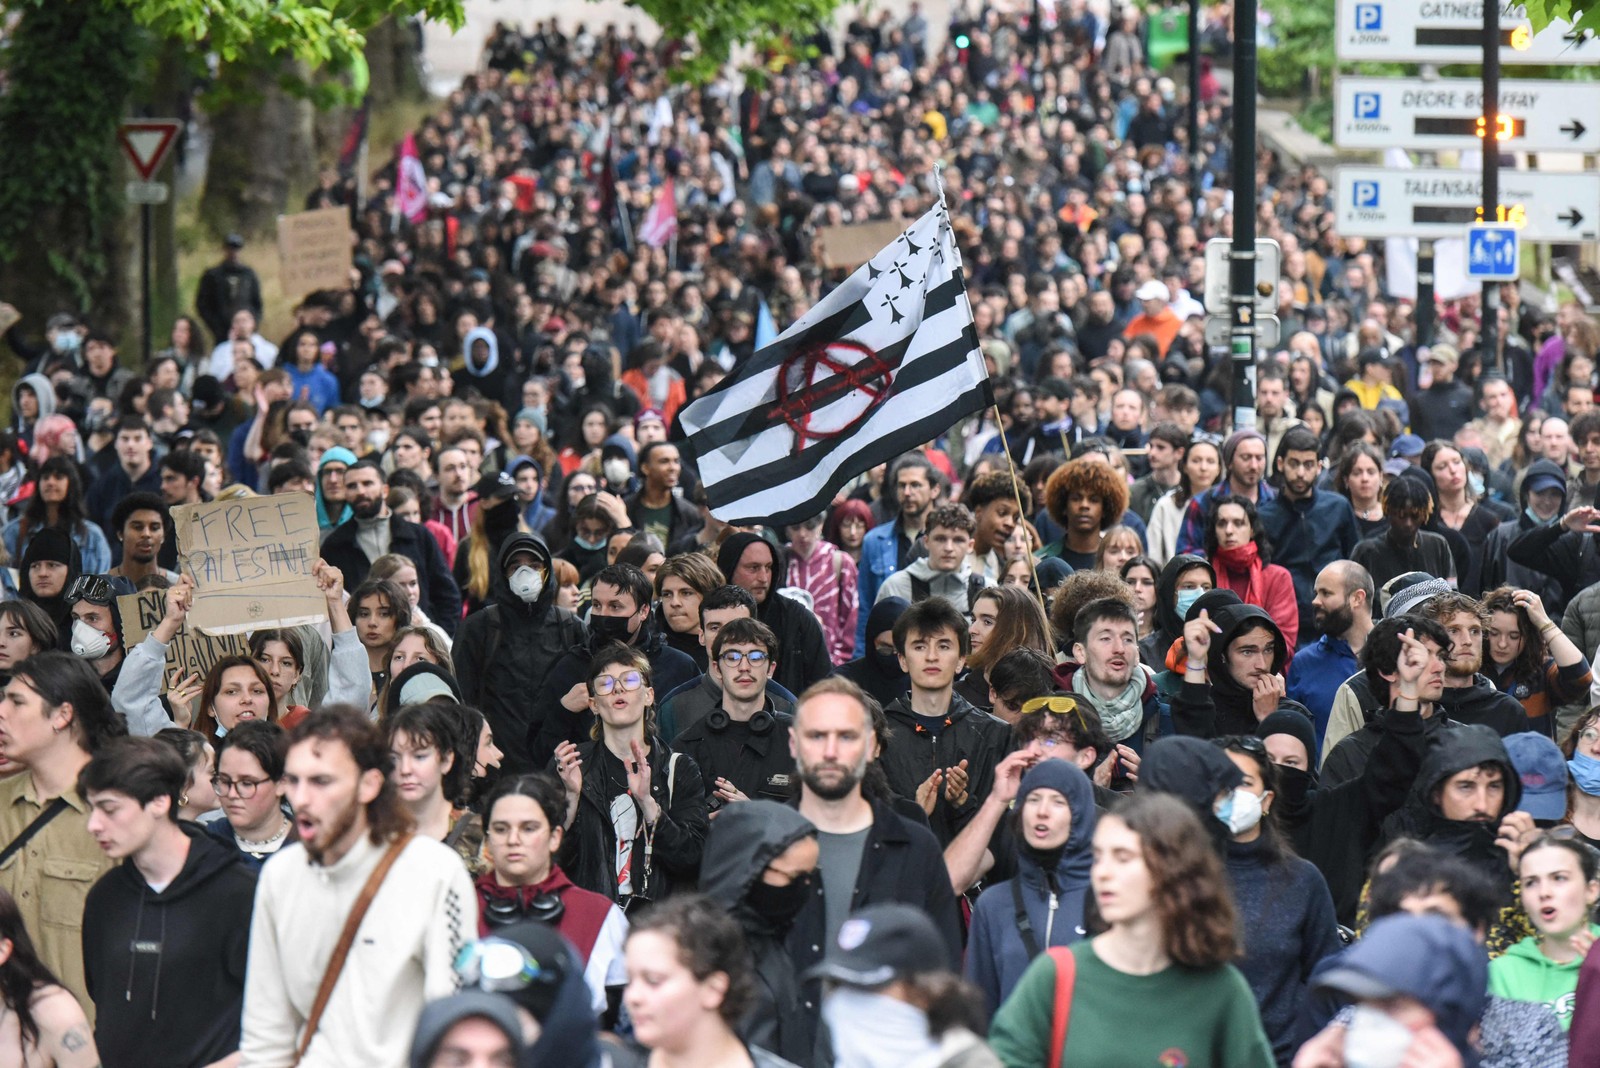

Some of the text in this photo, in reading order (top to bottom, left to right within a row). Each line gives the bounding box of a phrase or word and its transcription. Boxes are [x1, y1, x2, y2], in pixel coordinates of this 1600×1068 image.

[1358, 6, 1379, 31] P
[1419, 1, 1524, 19] CATHEDALE
[1357, 94, 1378, 119] P
[1356, 183, 1377, 207] P
[199, 501, 312, 547] FREE
[187, 539, 316, 589] PALESTINE
